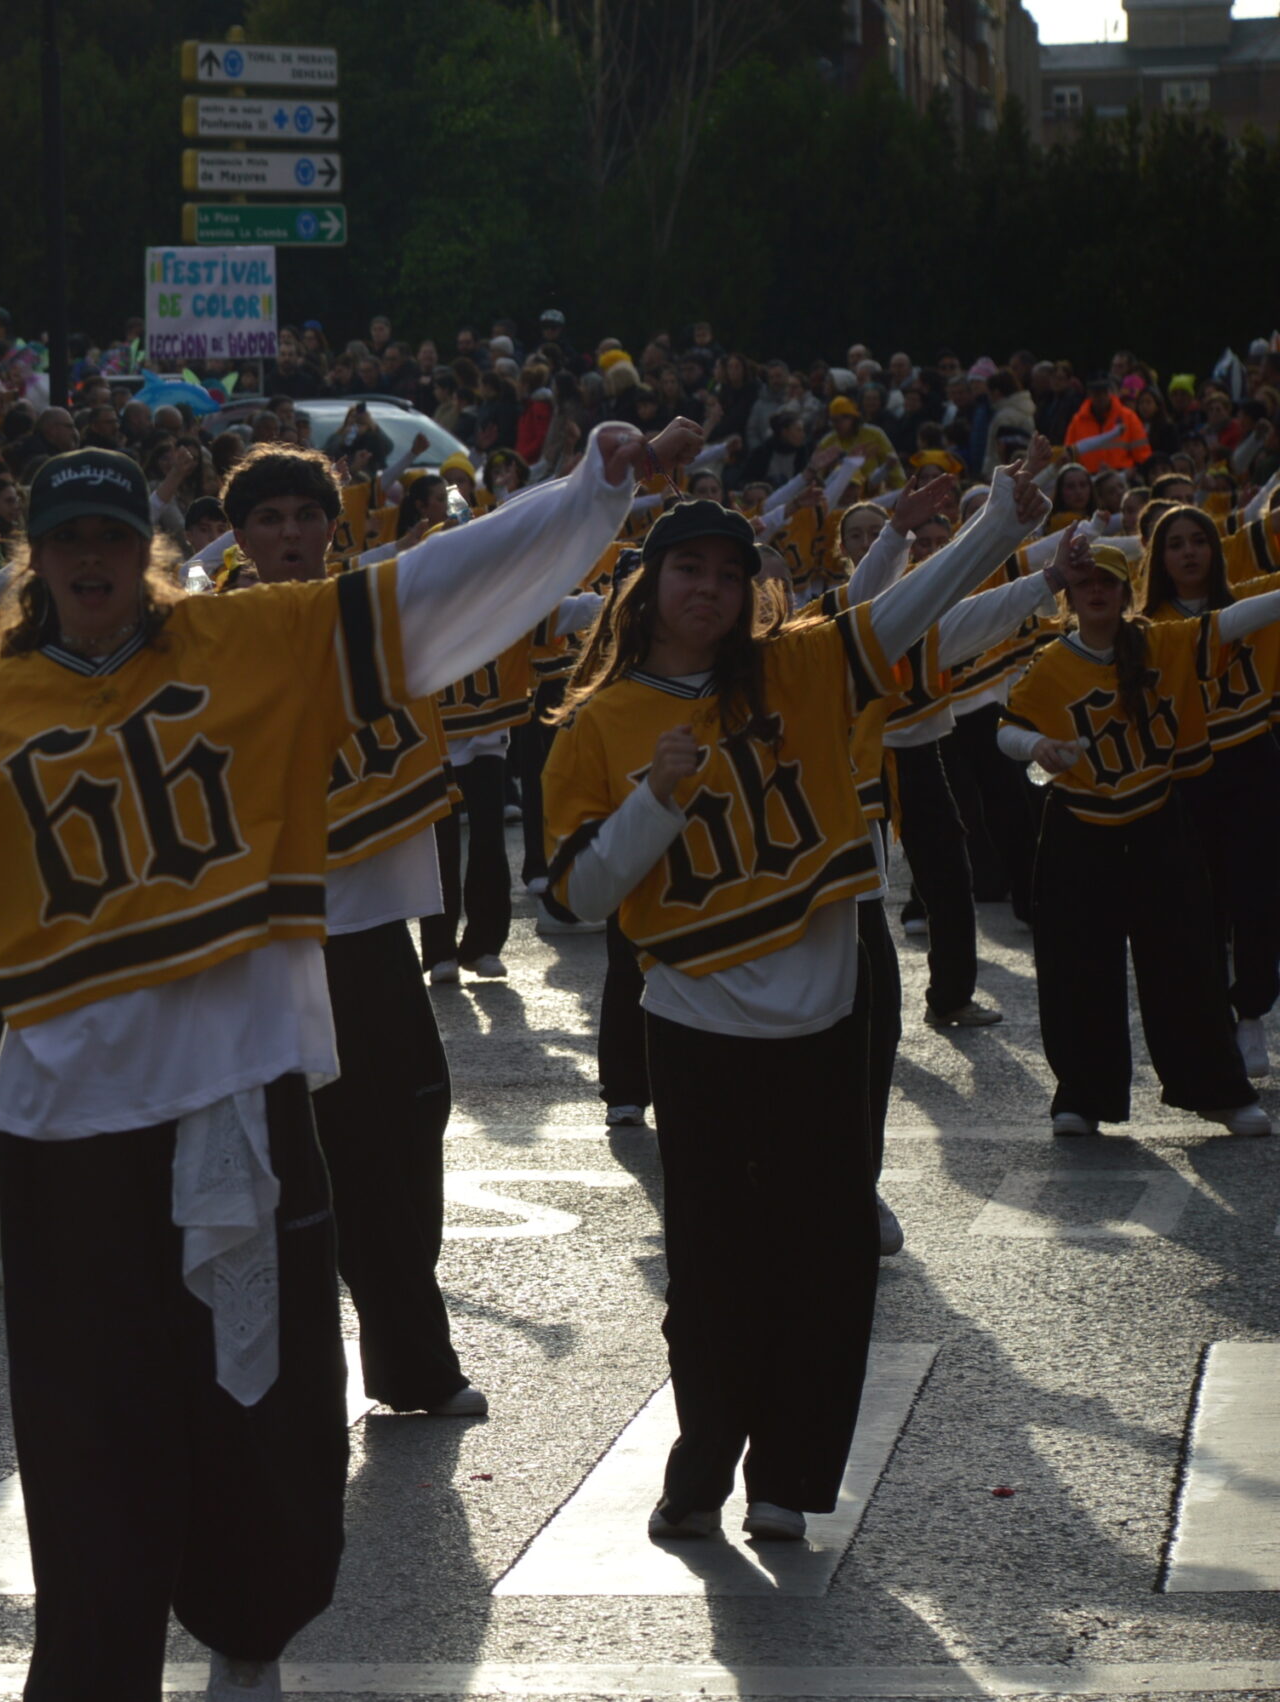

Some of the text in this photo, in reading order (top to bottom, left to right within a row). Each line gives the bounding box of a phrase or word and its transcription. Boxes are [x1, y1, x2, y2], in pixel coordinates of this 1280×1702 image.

[200, 170, 267, 184] de Mayores
[158, 292, 182, 317] DE
[0, 681, 252, 928] 66
